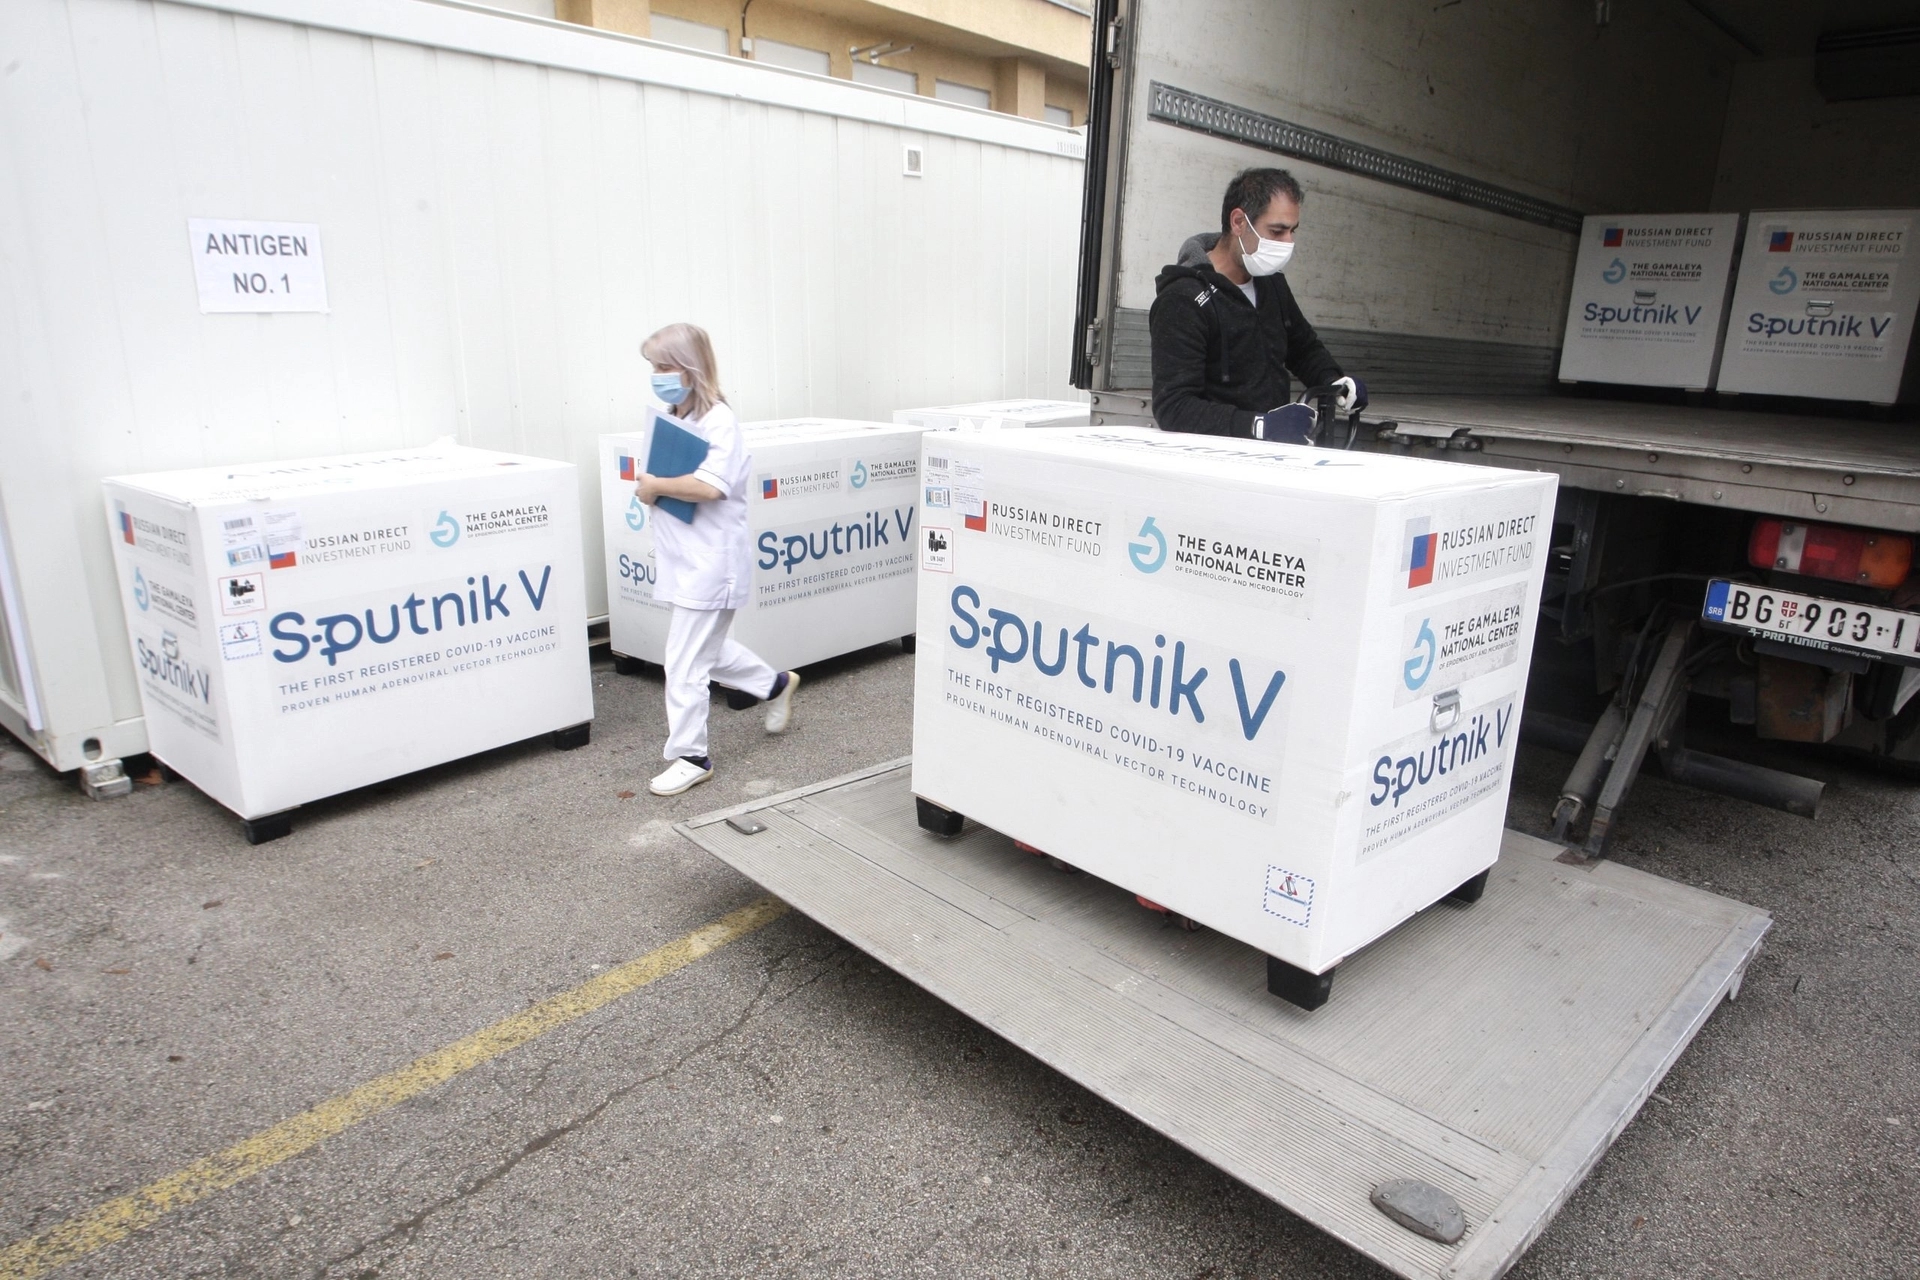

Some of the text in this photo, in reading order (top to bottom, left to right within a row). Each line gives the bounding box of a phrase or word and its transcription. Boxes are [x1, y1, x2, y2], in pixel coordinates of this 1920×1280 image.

[205, 233, 308, 256] ANTIGEN
[1626, 239, 1712, 247] INVESTMENT FUND
[1628, 228, 1713, 236] RUSSIAN DIRECT
[1798, 232, 1903, 240] RUSSIAN DIRECT
[1796, 244, 1900, 253] INVESTMENT FUND
[233, 272, 290, 294] NO. 1
[1829, 272, 1889, 280] GAMALEYA
[1584, 302, 1702, 326] Sputnik V
[1748, 312, 1891, 338] Sputnik V
[780, 470, 839, 486] RUSSIAN DIRECT
[871, 470, 896, 478] NATIONAL
[884, 460, 916, 469] GAMALEYA
[780, 481, 840, 497] INVESTMENT FUND
[466, 504, 547, 522] THE GAMALEYA
[466, 514, 548, 532] NATIONAL CENTER
[992, 503, 1102, 536] RUSSIAN DIRECT
[363, 526, 408, 541] DIRECT
[757, 506, 914, 575] Sputnik V
[992, 522, 1101, 556] INVESTMENT FUND
[1442, 515, 1536, 551] RUSSIAN DIRECT
[301, 540, 411, 565] INVESTMENT FUND
[1178, 534, 1306, 572] THE GAMALEYA
[1438, 542, 1532, 581] INVESTMENT FUND
[759, 584, 775, 594] THE
[778, 579, 800, 590] FIRST
[803, 568, 849, 584] REGISTERED
[851, 560, 883, 574] COVID-19
[886, 553, 913, 566] VACCINE
[1176, 550, 1305, 588] NATIONAL CENTER
[1185, 568, 1231, 582] EPIDEMIOLOGY
[1232, 579, 1247, 587] AND
[1249, 582, 1304, 598] MICROBIOLOGY
[759, 598, 786, 608] PROVEN
[788, 591, 812, 600] HUMAN
[814, 582, 852, 595] ADENOVIRAL
[854, 576, 876, 586] VECTOR
[1730, 590, 1774, 623] BG
[269, 574, 510, 666] Sputnik
[518, 565, 552, 611] V
[1445, 604, 1520, 640] THE GAMALEYA
[1708, 606, 1723, 616] SRB
[1779, 619, 1792, 630] БГ
[1440, 622, 1519, 658] NATIONAL CENTER
[1762, 630, 1787, 642] PRO
[1788, 635, 1830, 650] TUNING
[138, 638, 198, 698] Sputnik
[196, 669, 209, 704] V
[279, 626, 555, 695] THE FIRST REGISTERED COVID-19 VACCINE
[949, 585, 1286, 741] Sputnik V
[282, 642, 556, 713] PROVEN HUMAN ADENOVIRAL VECTOR TECHNOLOGY
[948, 668, 1271, 793] THE FIRST REGISTERED COVID-19 VACCINE
[946, 692, 1268, 818] PROVEN HUMAN ADENOVIRAL VECTOR TECHNOLOGY
[1370, 703, 1512, 808] Sputnik V
[1366, 762, 1503, 838] THE FIRST REGISTERED COVID-19 VACCINE
[1362, 838, 1388, 855] PROVEN
[1390, 827, 1411, 841] HUMAN
[1413, 809, 1448, 829] ADENOVIRAL
[1450, 799, 1469, 812] VECTOR
